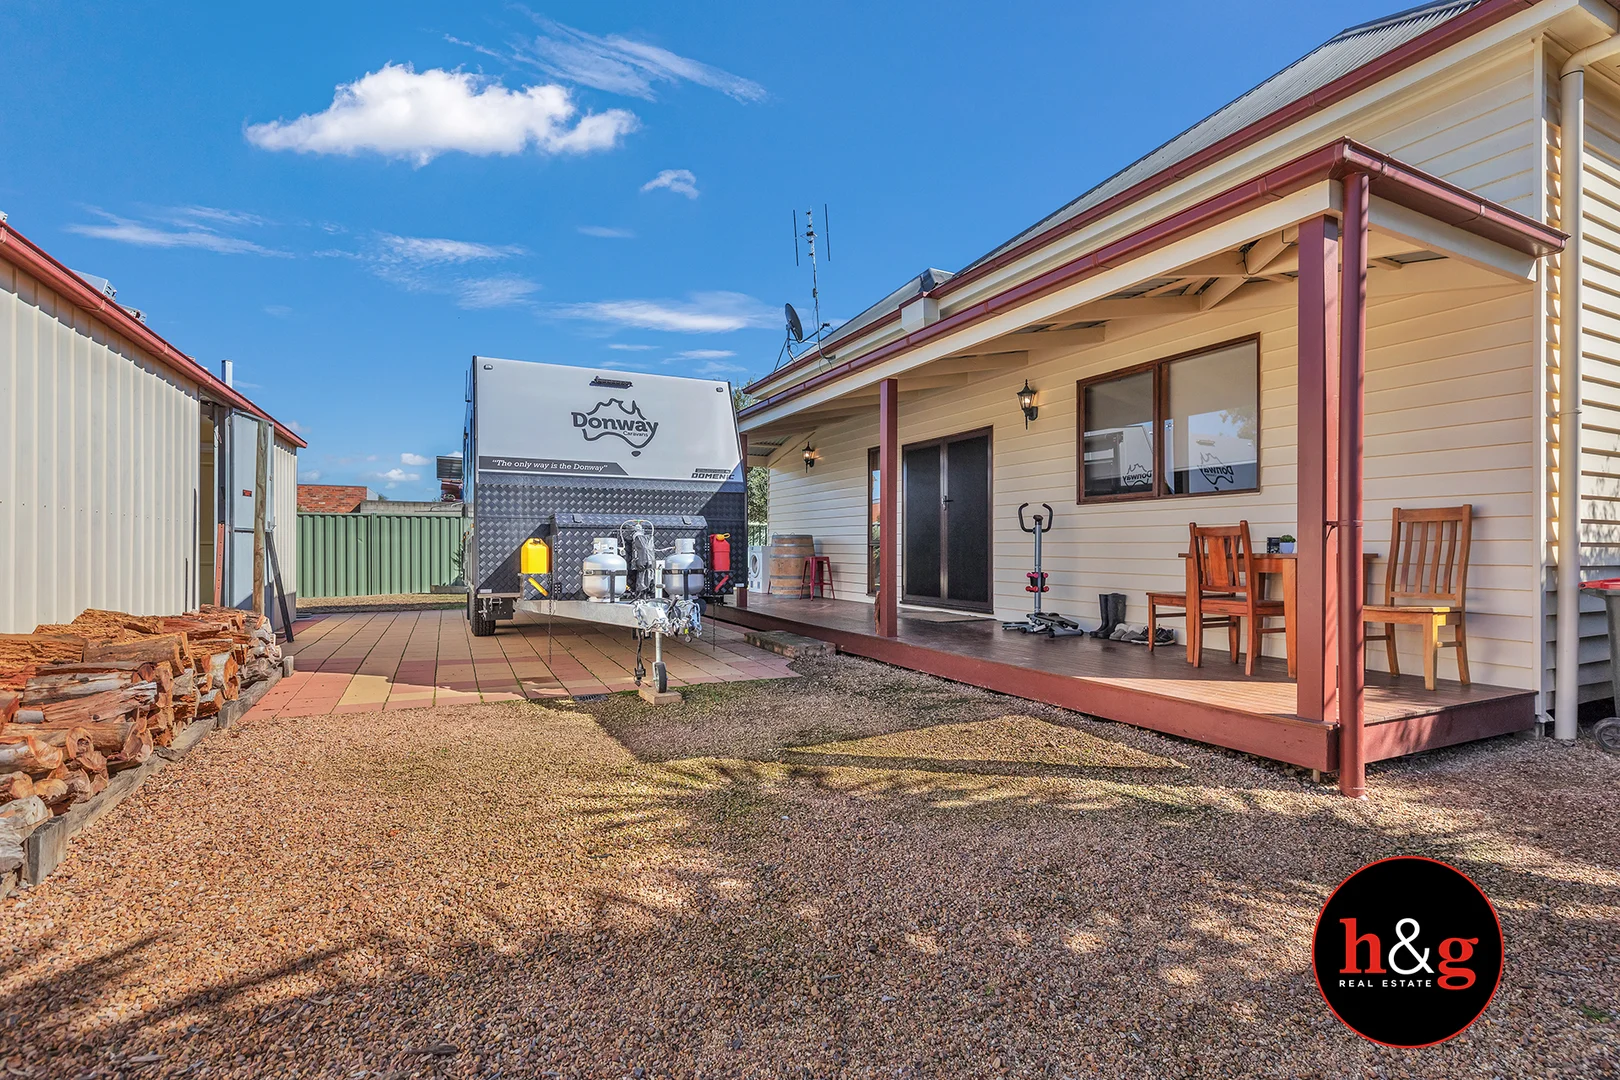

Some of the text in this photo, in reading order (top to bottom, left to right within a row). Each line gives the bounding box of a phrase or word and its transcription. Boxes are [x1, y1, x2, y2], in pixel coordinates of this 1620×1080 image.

[570, 411, 659, 435] Donway
[513, 461, 532, 469] only
[533, 462, 550, 470] way
[550, 461, 558, 469] is
[559, 462, 572, 470] the
